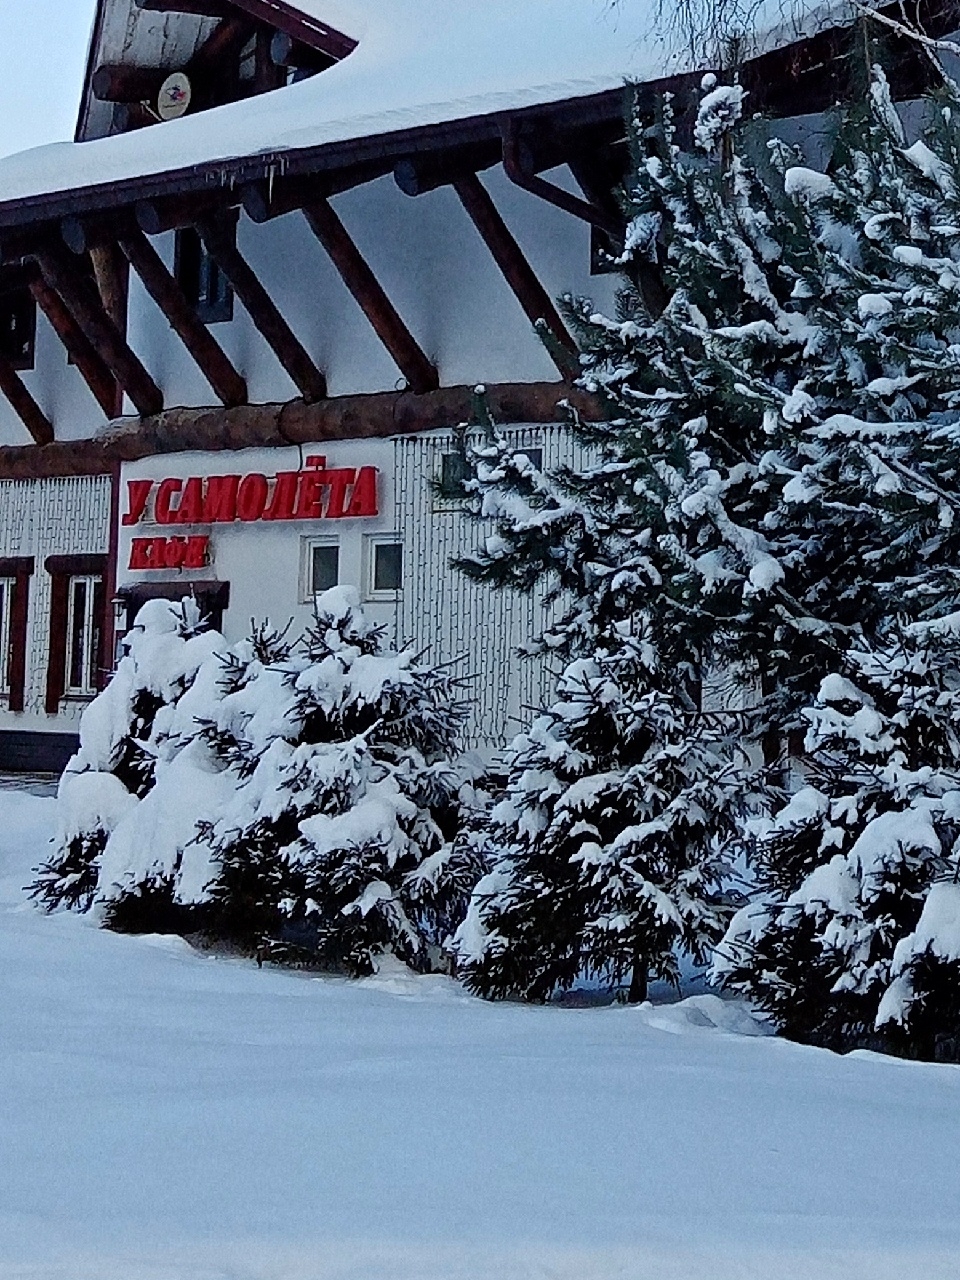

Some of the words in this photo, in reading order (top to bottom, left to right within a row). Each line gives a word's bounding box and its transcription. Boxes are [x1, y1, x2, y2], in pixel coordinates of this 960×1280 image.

[122, 479, 154, 526] У
[155, 455, 379, 524] САМОЛЁТА
[128, 535, 210, 570] КАФЕ
